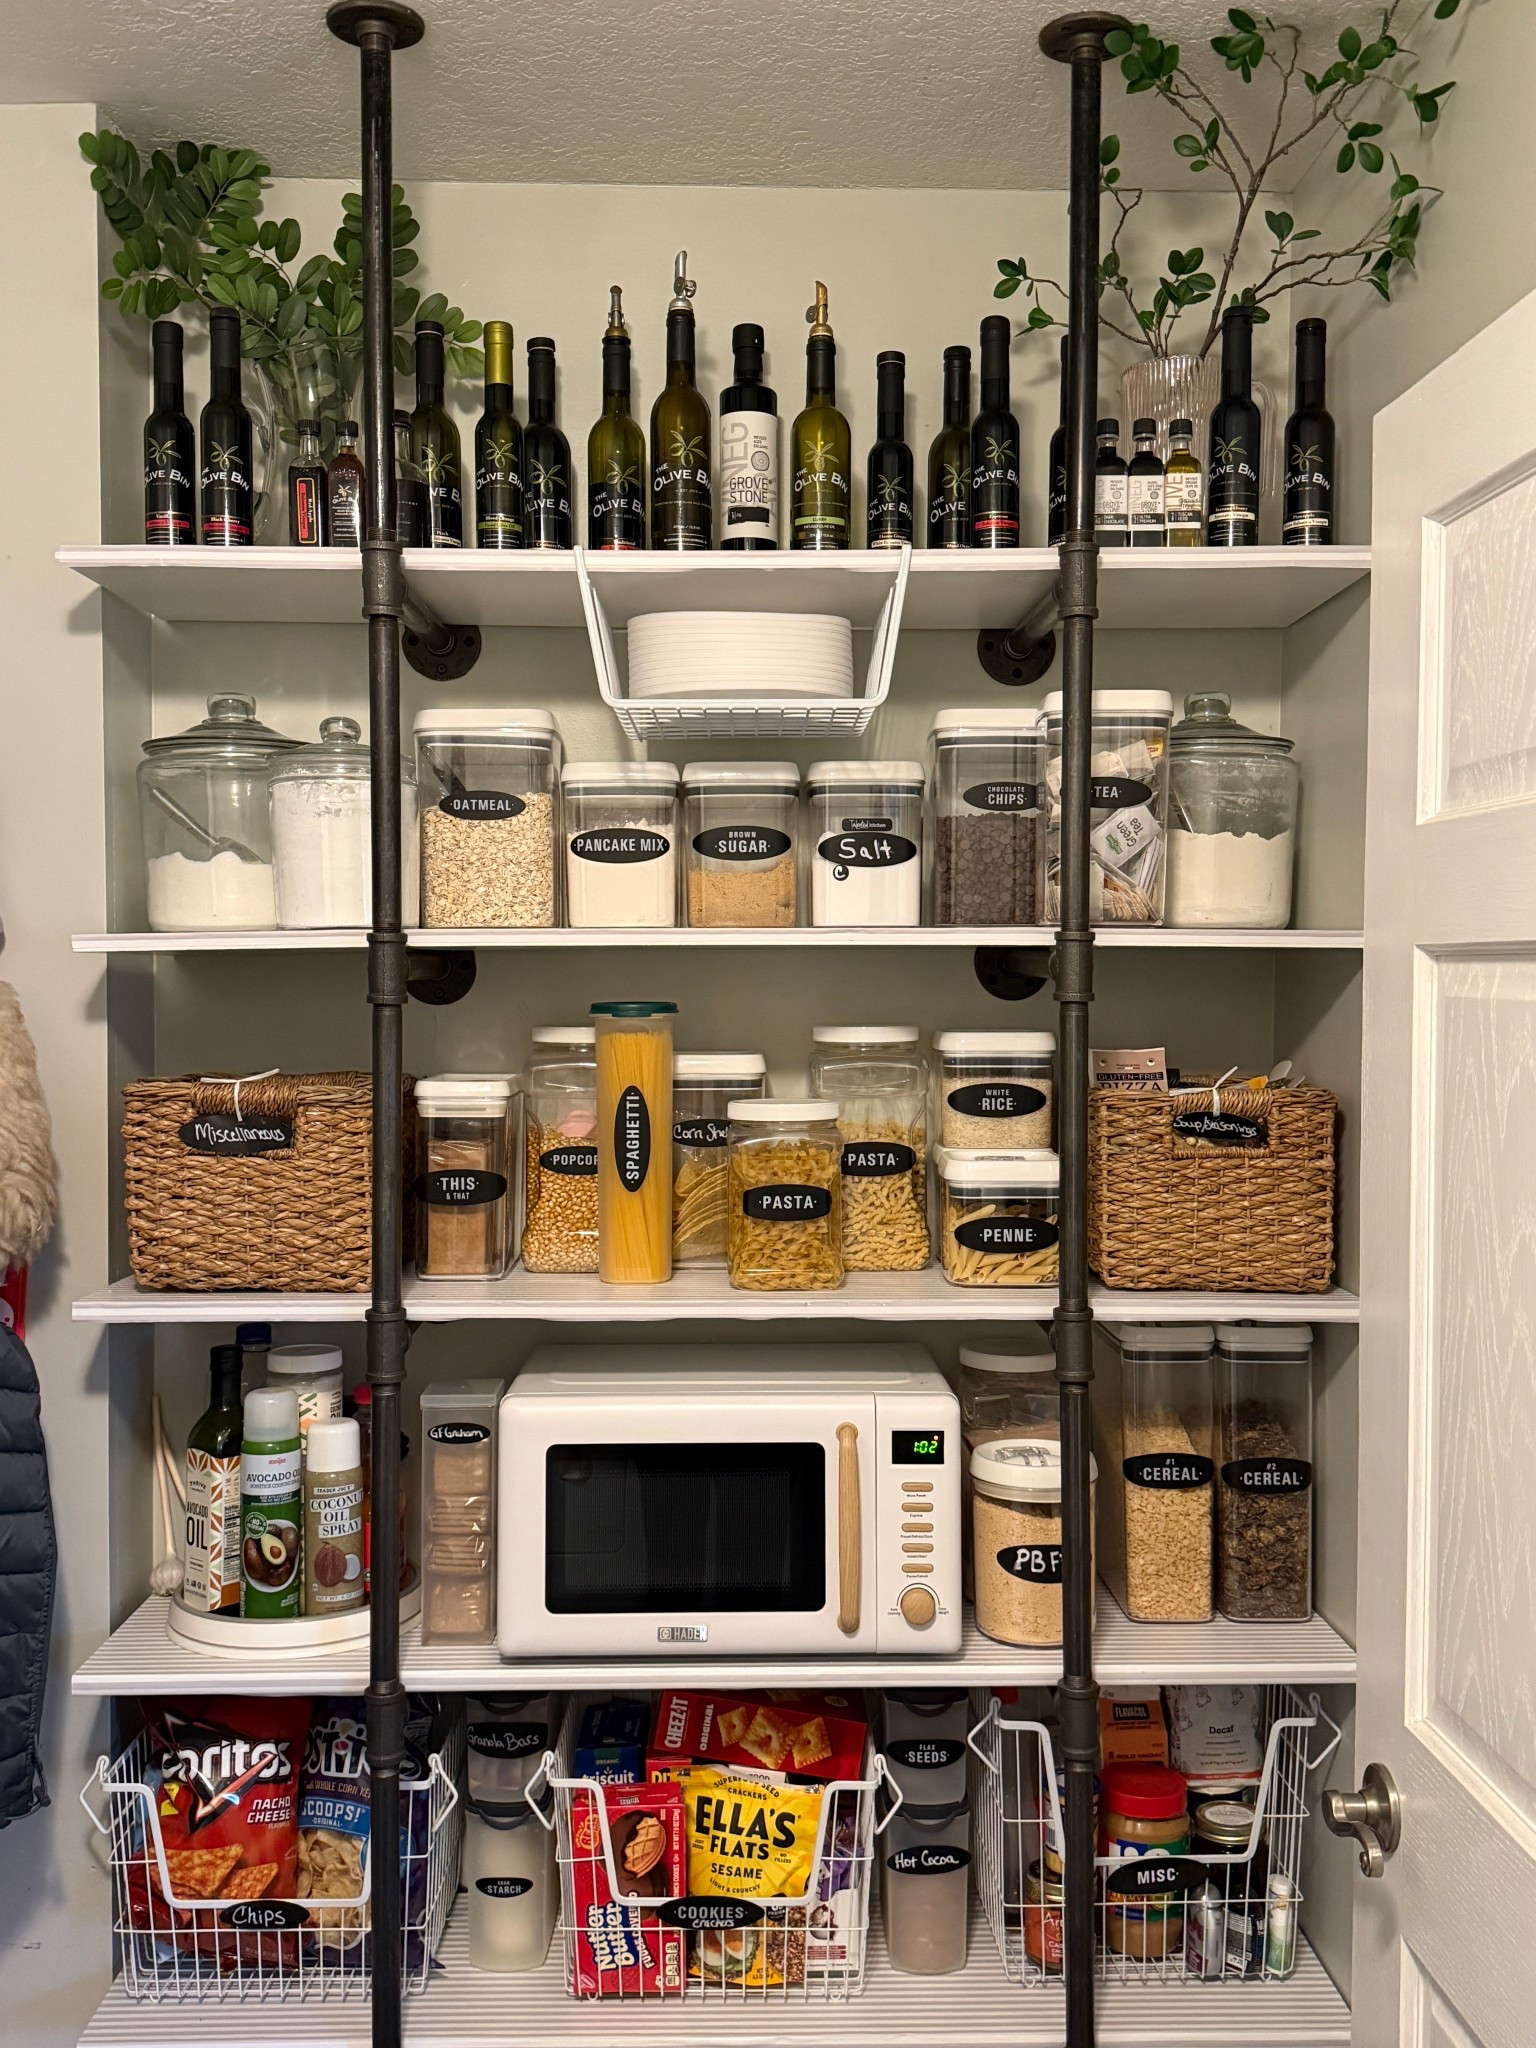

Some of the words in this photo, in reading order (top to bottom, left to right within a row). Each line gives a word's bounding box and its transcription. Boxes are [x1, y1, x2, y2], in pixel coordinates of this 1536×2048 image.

[655, 462, 669, 475] THE
[796, 467, 808, 478] THE
[974, 464, 985, 476] THE
[1237, 462, 1257, 482] BIN
[169, 468, 191, 489] BIN
[231, 471, 250, 492] BIN
[476, 472, 505, 490] OLIVE
[653, 469, 692, 492] OLIVE
[729, 476, 769, 491] GROVE
[794, 472, 828, 492] OLIVE
[830, 471, 848, 494] BIN
[972, 469, 1004, 489] OLIVE
[1312, 472, 1331, 491] BIN
[594, 491, 608, 502] THE
[729, 490, 769, 504] STONE
[931, 495, 945, 507] THE
[592, 498, 629, 518] OLIVE
[868, 502, 896, 521] OLIVE
[929, 501, 966, 523] OLIVE
[987, 793, 1024, 805] CHIPS
[1094, 786, 1119, 798] TEA
[453, 798, 511, 811] OATMEAL
[1116, 821, 1137, 848] Green
[1130, 818, 1144, 836] Tea
[576, 838, 636, 852] PANCAKE
[640, 838, 665, 852] MIX
[718, 839, 768, 853] SUGAR
[838, 838, 893, 860] Salt
[1098, 1072, 1162, 1080] GLUTEN-FREE
[981, 1097, 1014, 1111] RICE
[195, 1122, 285, 1146] Miscellaneous
[626, 1095, 640, 1180] SPAGHETTI
[673, 1126, 704, 1140] Corn
[848, 1153, 896, 1166] PASTA
[440, 1176, 475, 1191] THIS
[446, 1192, 451, 1200] &
[453, 1192, 470, 1200] THAT
[762, 1194, 814, 1209] PASTA
[983, 1228, 1034, 1243] PENNE
[430, 1426, 443, 1439] GF
[913, 1440, 938, 1454] 1:02
[269, 1457, 287, 1465] meijer
[1165, 1458, 1176, 1466] #1
[246, 1472, 292, 1483] AVOCADO
[1143, 1466, 1199, 1482] CEREAL
[1243, 1471, 1300, 1486] CEREAL
[189, 1480, 207, 1490] THRIVE
[186, 1501, 209, 1519] AVOCADO
[324, 1511, 348, 1523] OIL
[186, 1516, 208, 1551] OIL
[322, 1519, 361, 1536] SPRAY
[1015, 1548, 1046, 1573] PB
[1114, 1706, 1148, 1718] FLAVACOL
[664, 1696, 688, 1748] CHEEZ-IT
[699, 1704, 715, 1752] ORIGINAL
[1208, 1724, 1235, 1735] Decaf
[467, 1726, 506, 1749] Granola
[506, 1732, 540, 1751] Bars
[908, 1750, 947, 1763] SEEDS
[314, 1780, 336, 1791] WHOLE
[338, 1782, 359, 1796] CORN
[727, 1787, 768, 1801] CRACKERS
[761, 1782, 780, 1798] SEED
[252, 1795, 291, 1810] NACHO
[246, 1808, 291, 1824] CHEESE
[313, 1817, 340, 1828] ORIGINAL
[695, 1795, 796, 1848] ELLA'S
[710, 1835, 769, 1860] FLATS
[894, 1853, 918, 1870] Hot
[920, 1850, 960, 1867] Cocoa
[711, 1862, 763, 1880] SESAME
[1137, 1867, 1176, 1885] MISC
[487, 1884, 521, 1895] STARCH
[709, 1878, 725, 1891] LIGHT
[732, 1884, 761, 1894] CRUNCHY
[232, 1906, 286, 1927] Chips
[677, 1906, 745, 1919] COOKIES
[588, 1904, 617, 1971] Nutter
[606, 1902, 635, 1967] Butter
